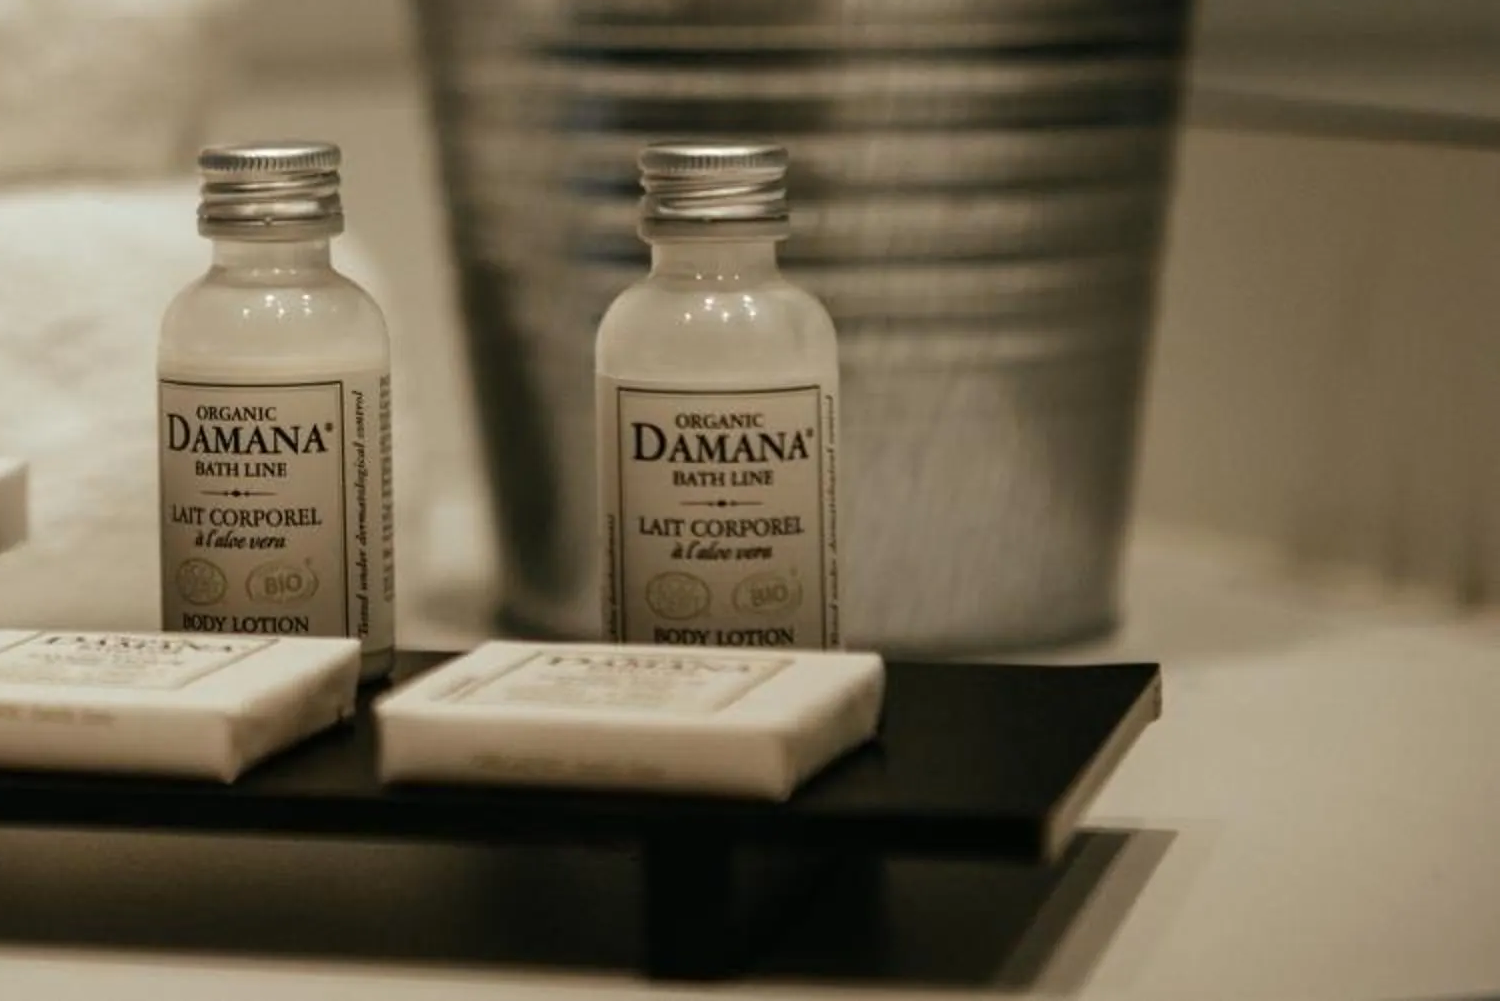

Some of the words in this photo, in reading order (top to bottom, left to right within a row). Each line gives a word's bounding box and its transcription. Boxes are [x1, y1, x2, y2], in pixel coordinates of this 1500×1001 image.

[196, 406, 277, 422] ORGANIC
[675, 413, 764, 429] ORGANIC
[167, 413, 328, 455] DAMANA
[631, 422, 809, 463] DAMANA
[195, 461, 239, 477] BATH
[243, 462, 287, 478] LINE
[673, 470, 725, 487] BATH
[731, 470, 774, 487] LINE
[171, 503, 206, 526] LAIT
[209, 507, 322, 528] CORPOREL
[638, 516, 685, 537] LAIT
[690, 516, 804, 537] CORPOREL
[249, 535, 286, 549] vera
[264, 572, 301, 594] BIO
[182, 613, 227, 633] BODY
[233, 616, 309, 633] LOTION
[654, 627, 710, 646] BODY
[717, 628, 794, 646] LOTION
